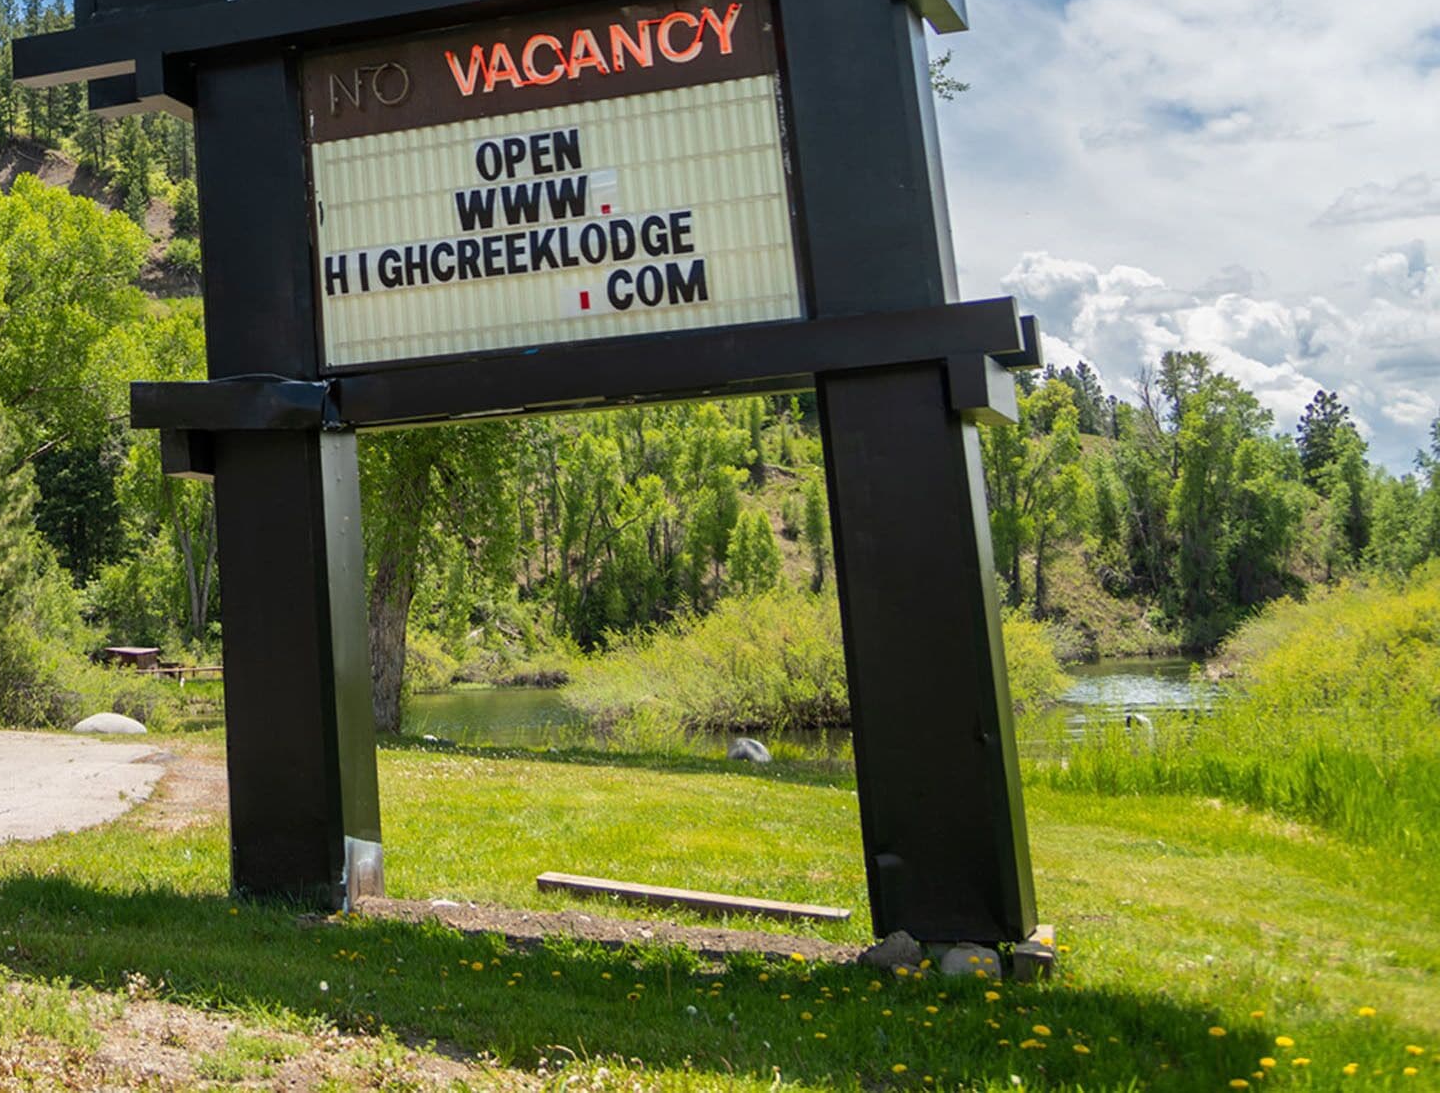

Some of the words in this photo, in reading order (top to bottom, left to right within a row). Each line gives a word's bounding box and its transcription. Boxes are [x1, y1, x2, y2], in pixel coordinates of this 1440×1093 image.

[329, 60, 410, 115] NO
[445, 3, 743, 96] VACANCY
[475, 128, 582, 182] OPEN
